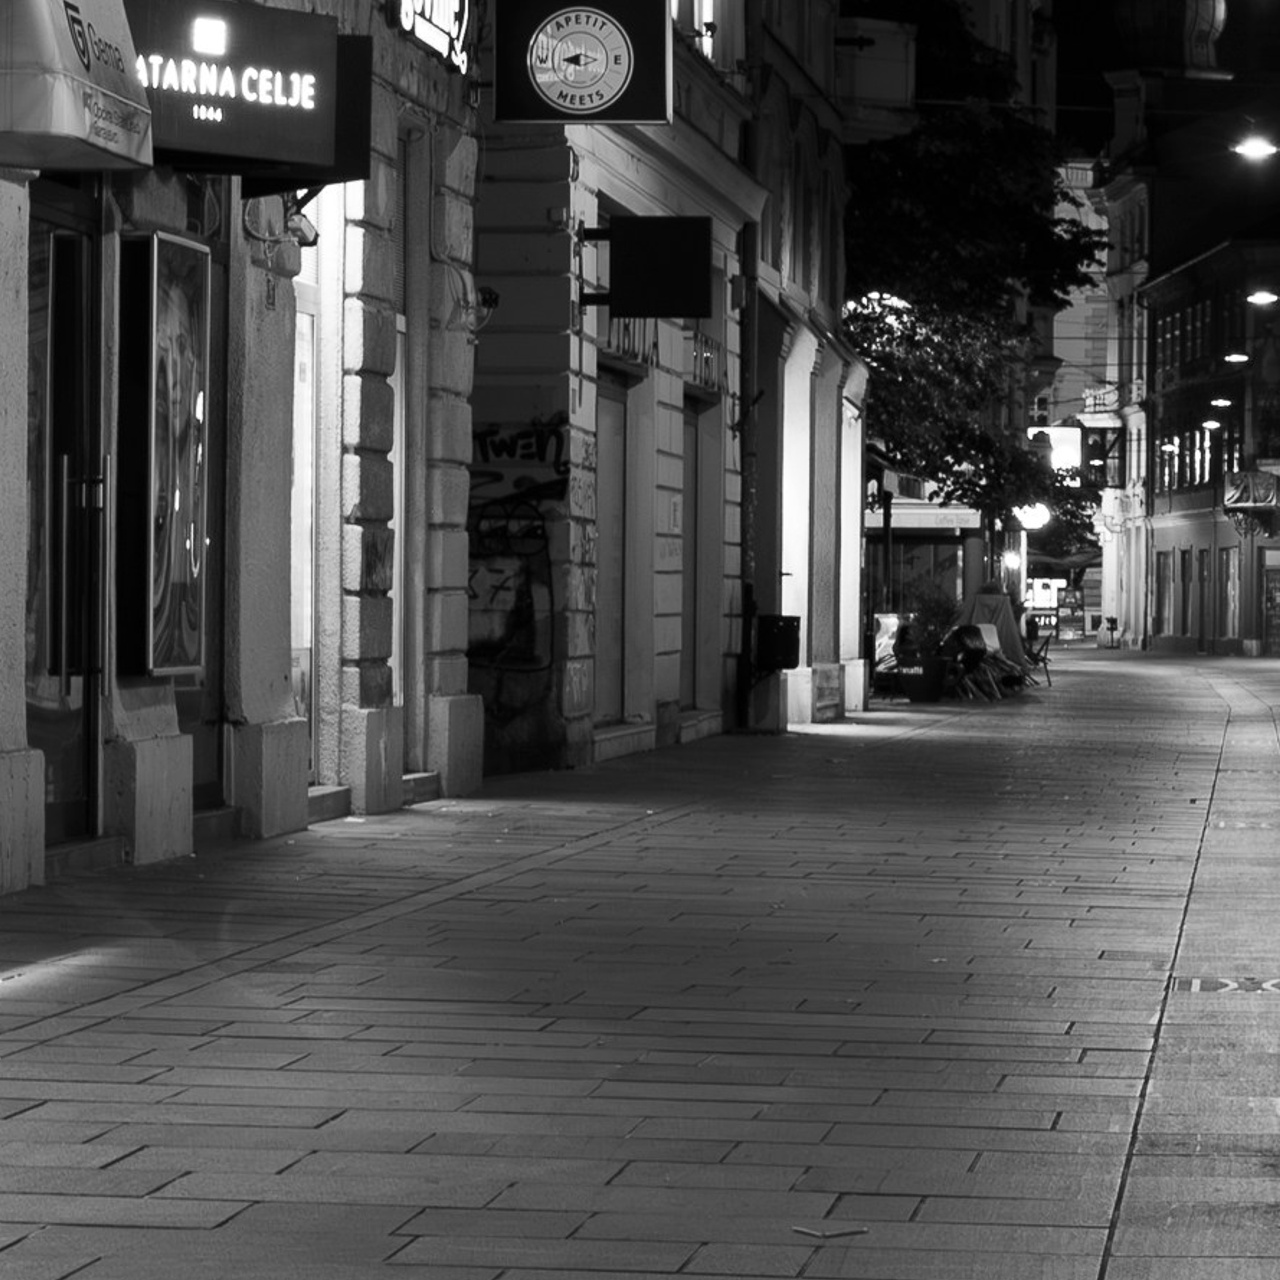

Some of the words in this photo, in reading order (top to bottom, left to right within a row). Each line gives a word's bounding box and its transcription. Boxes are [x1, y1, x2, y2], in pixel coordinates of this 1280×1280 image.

[555, 14, 608, 32] APETIT
[241, 67, 316, 110] CELJE
[556, 89, 605, 107] MEETS
